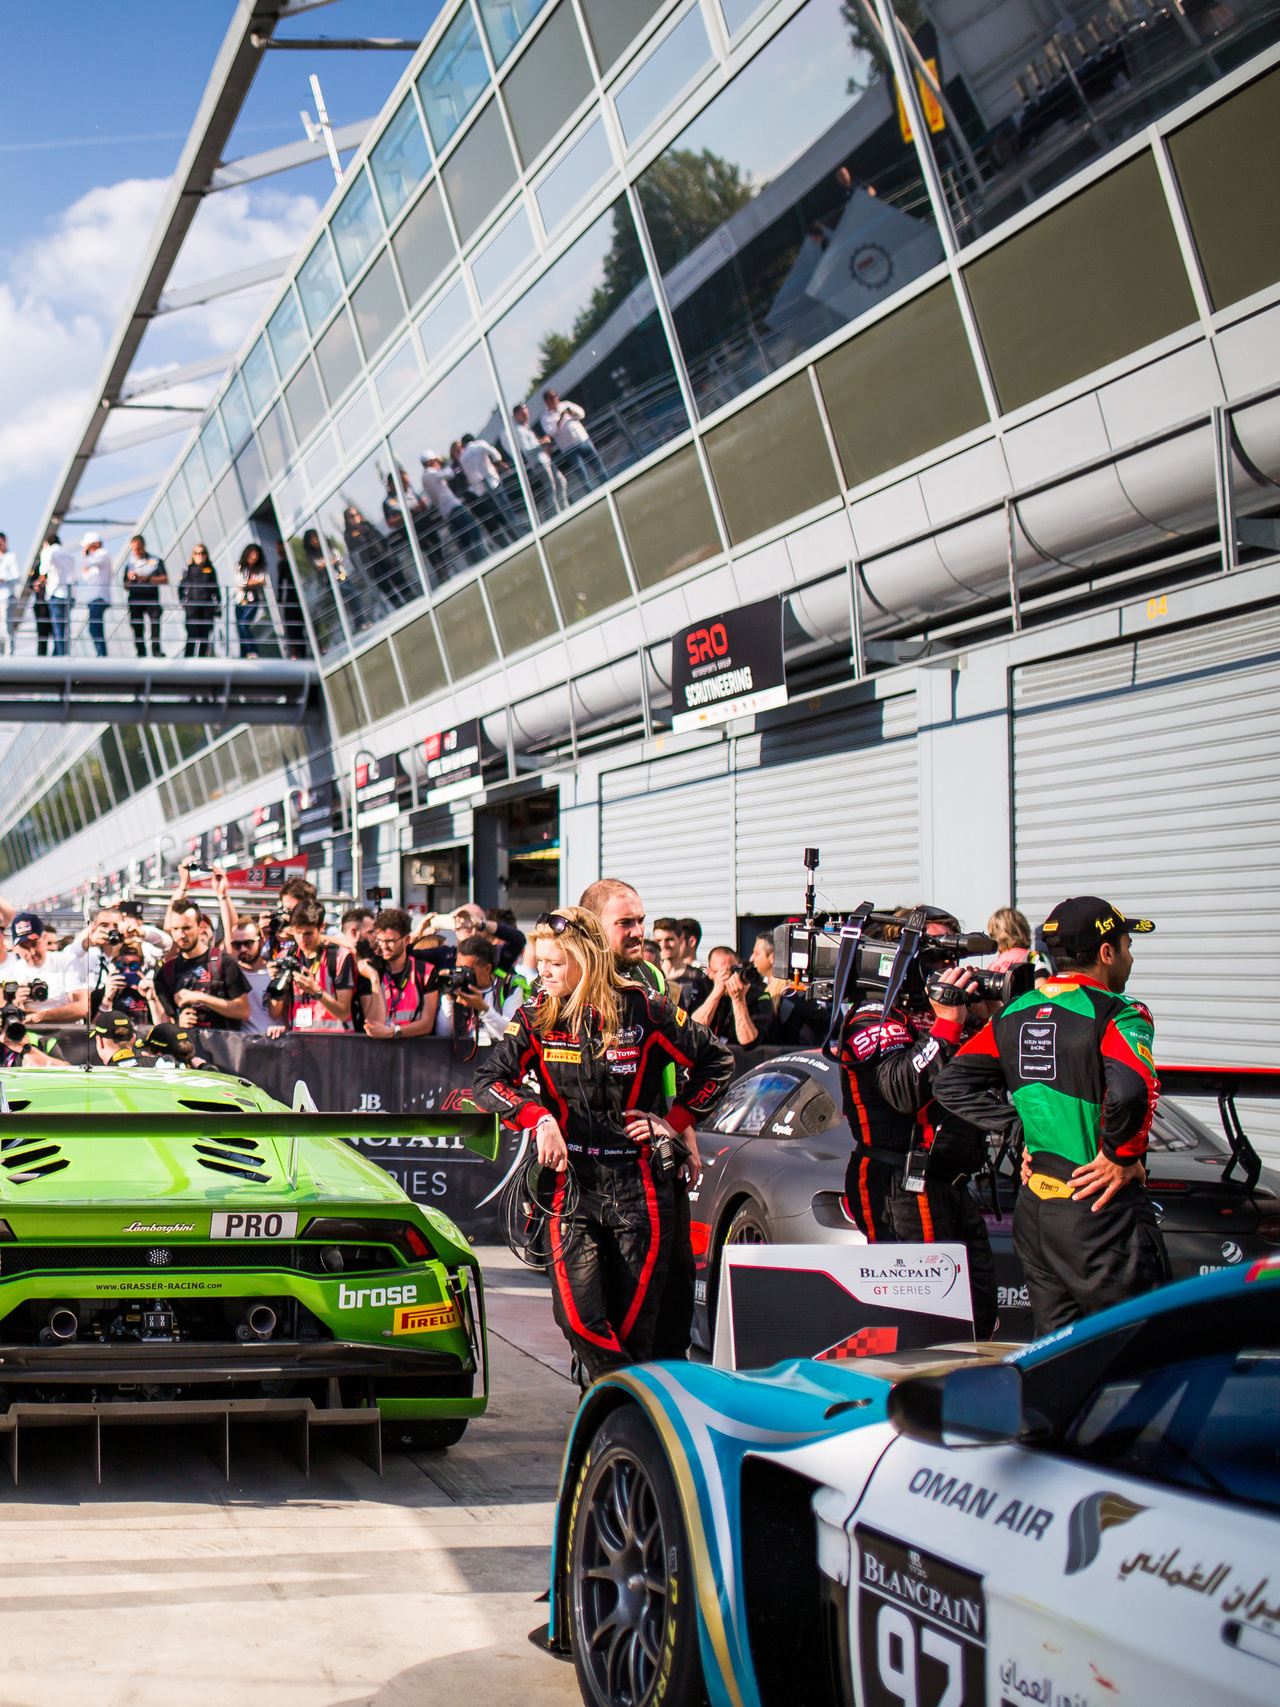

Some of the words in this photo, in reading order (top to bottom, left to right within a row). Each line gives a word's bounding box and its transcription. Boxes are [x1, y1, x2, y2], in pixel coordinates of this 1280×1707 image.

[1146, 595, 1168, 620] 04
[686, 623, 728, 666] SRO
[684, 666, 754, 708] SCRUTINEERING
[1095, 917, 1116, 935] 1ST
[853, 1024, 906, 1052] SRO
[122, 1220, 196, 1234] Lamborghini
[225, 1213, 284, 1238] PRO
[859, 1267, 941, 1278] BLANCPAIN
[338, 1283, 417, 1310] brose
[873, 1285, 888, 1295] GT
[892, 1285, 931, 1295] SERIES
[401, 1306, 457, 1330] PIRELLI
[908, 1467, 1000, 1520] OMAN
[993, 1499, 1055, 1541] AIR
[863, 1552, 980, 1634] BLANCPAIN
[877, 1604, 965, 1707] 97
